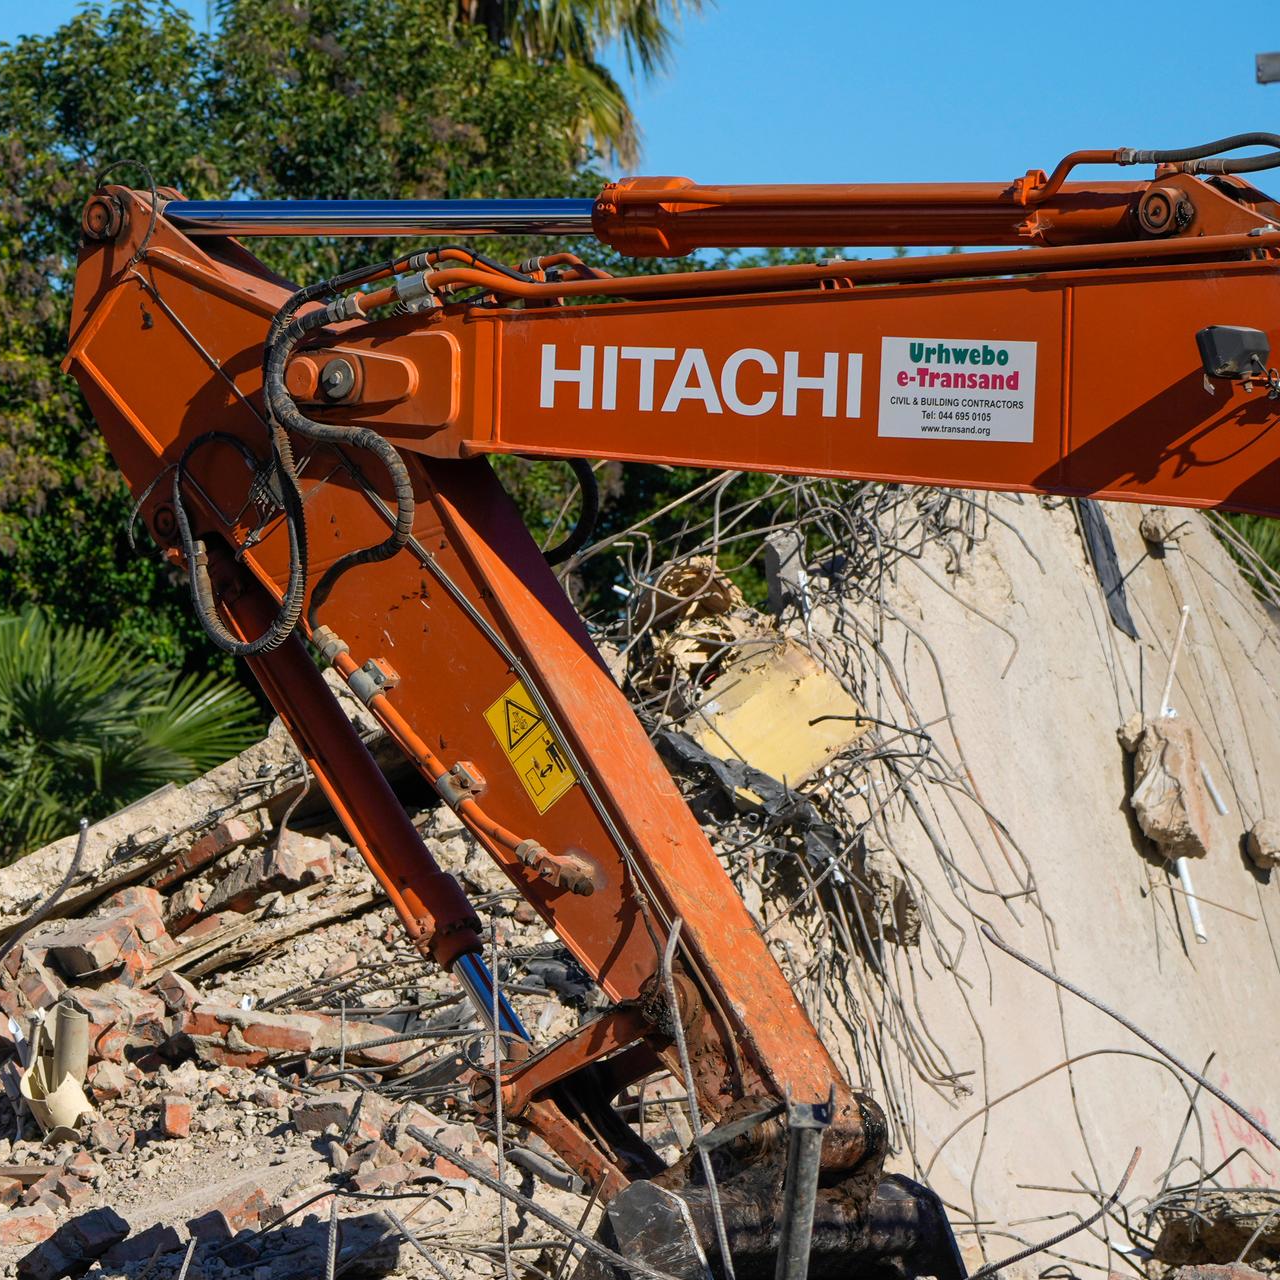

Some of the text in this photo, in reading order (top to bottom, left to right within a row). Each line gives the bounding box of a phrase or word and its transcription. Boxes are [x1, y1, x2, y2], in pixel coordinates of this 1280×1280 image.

[909, 342, 1009, 366] Urhwebo
[539, 343, 864, 418] HITACHI
[896, 367, 1020, 391] e-Transand
[890, 396, 1025, 410] CIVIL & BUILDING CONTRACTORS
[921, 410, 992, 422] Tel: 044 695 0105
[920, 425, 992, 437] www.transand.org
